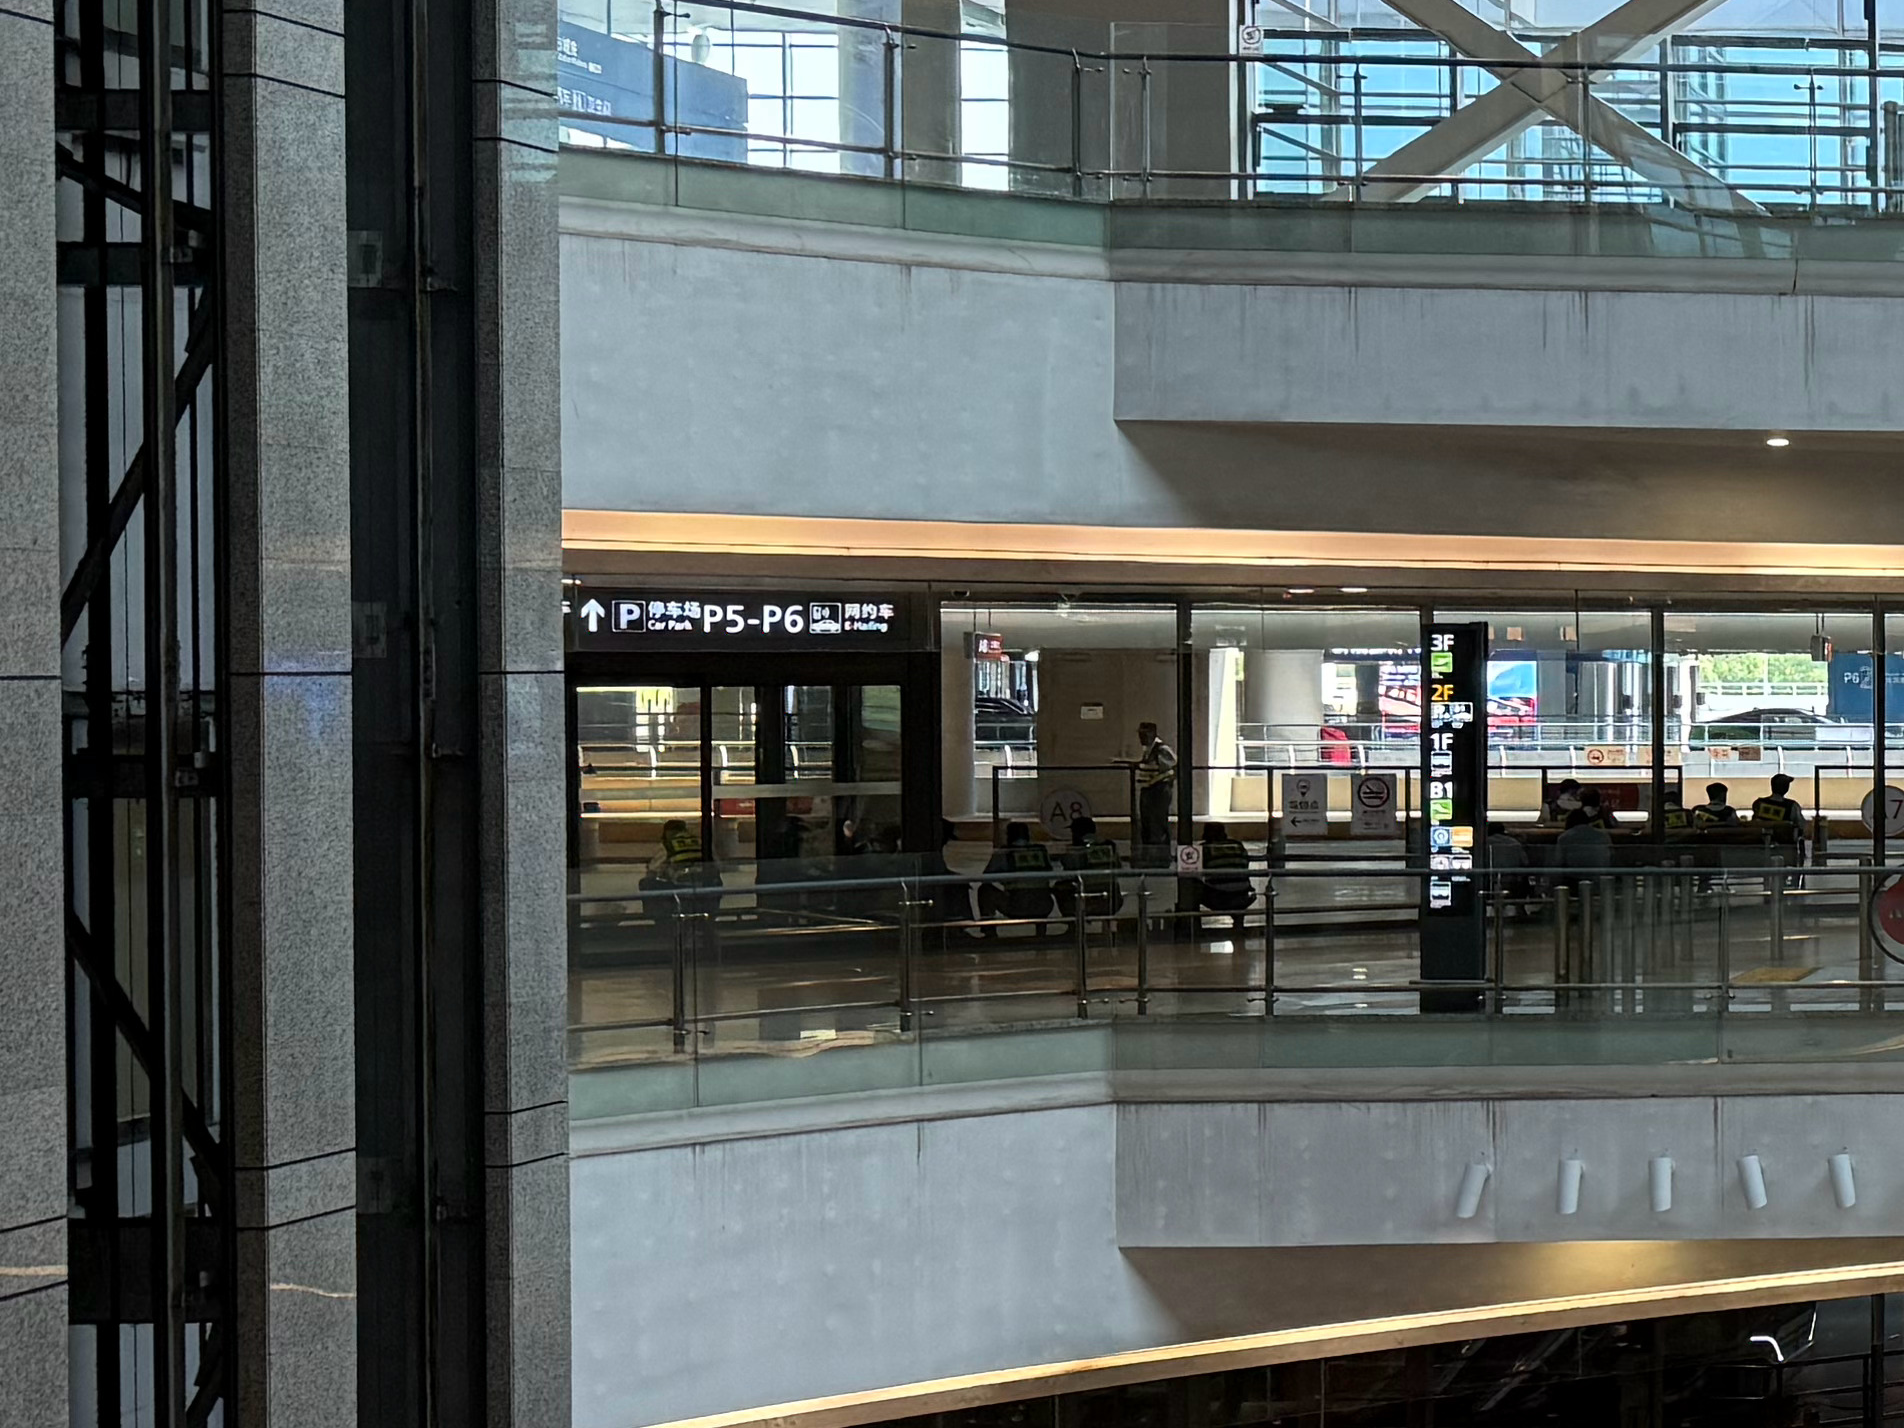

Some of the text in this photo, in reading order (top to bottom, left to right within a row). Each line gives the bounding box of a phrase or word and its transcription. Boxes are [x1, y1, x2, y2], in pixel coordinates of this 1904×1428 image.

[648, 601, 701, 619] 停车场
[703, 604, 804, 634] P5-P6
[844, 603, 895, 619] 网约车
[1431, 634, 1455, 651] 3F
[1431, 684, 1454, 701] 2F
[1430, 733, 1454, 750] 1F
[1430, 781, 1453, 799] B1
[1051, 801, 1083, 819] A8
